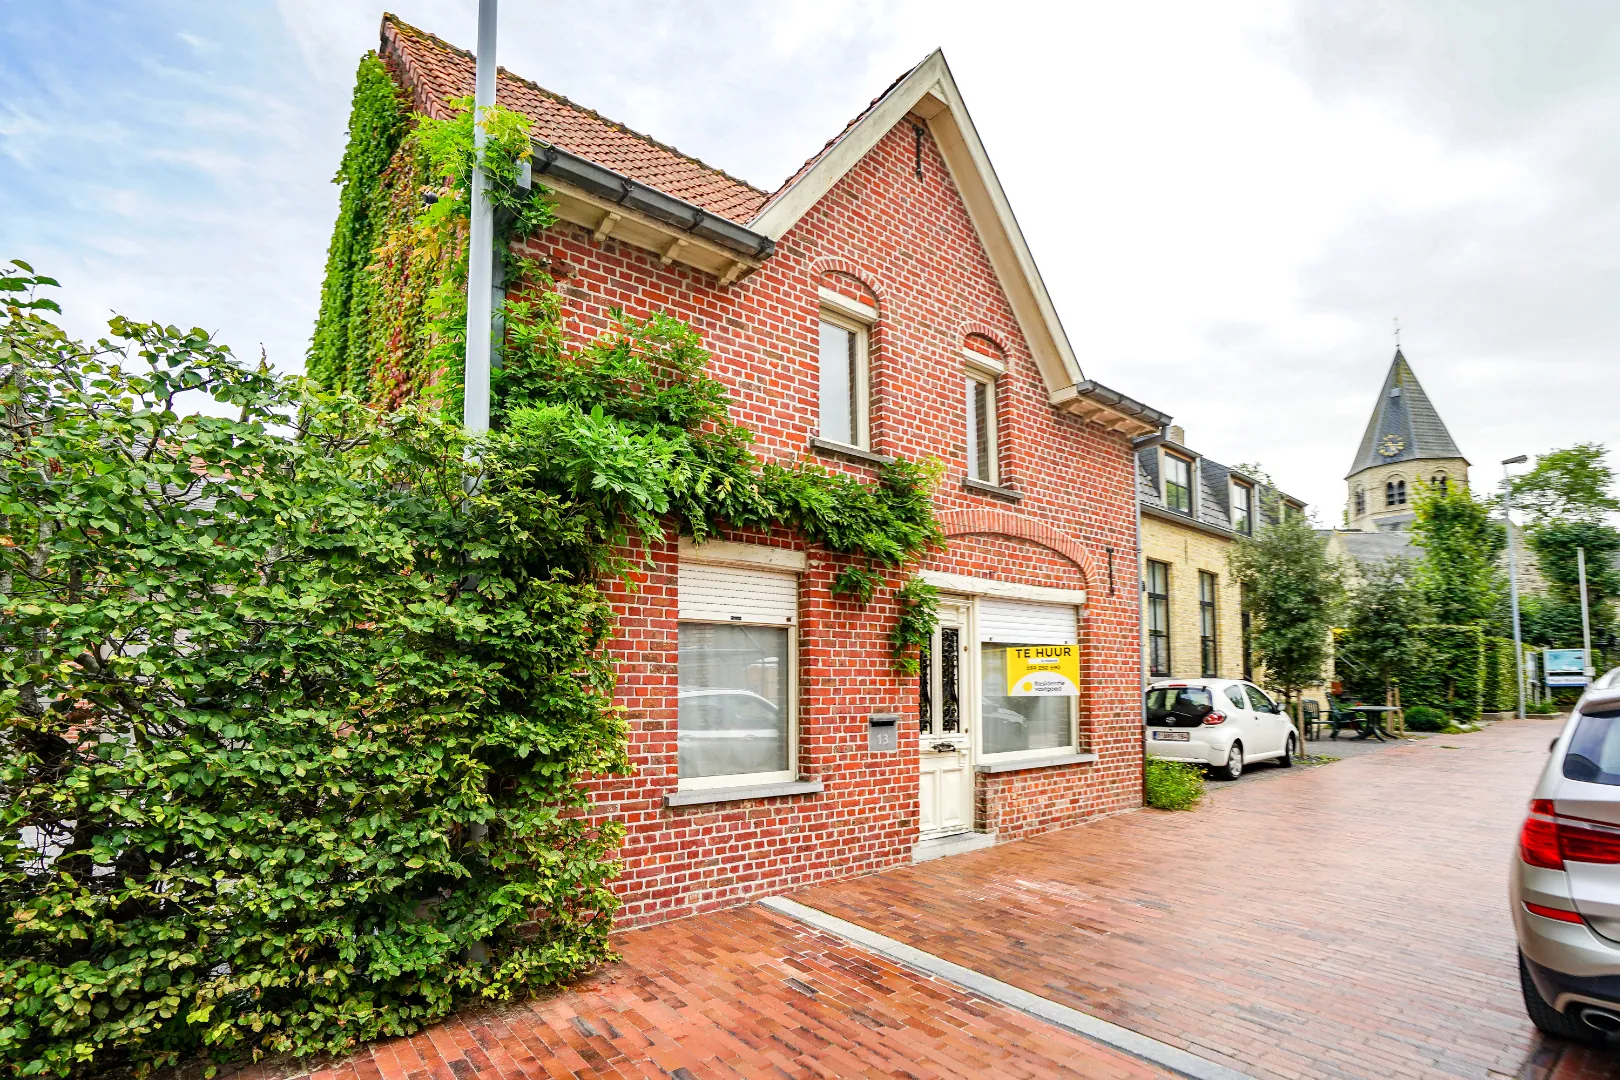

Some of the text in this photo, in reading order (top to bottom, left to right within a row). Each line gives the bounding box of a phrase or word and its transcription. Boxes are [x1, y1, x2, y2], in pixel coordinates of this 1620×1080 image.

[1015, 647, 1071, 658] TE HUUR
[876, 733, 889, 745] 13
